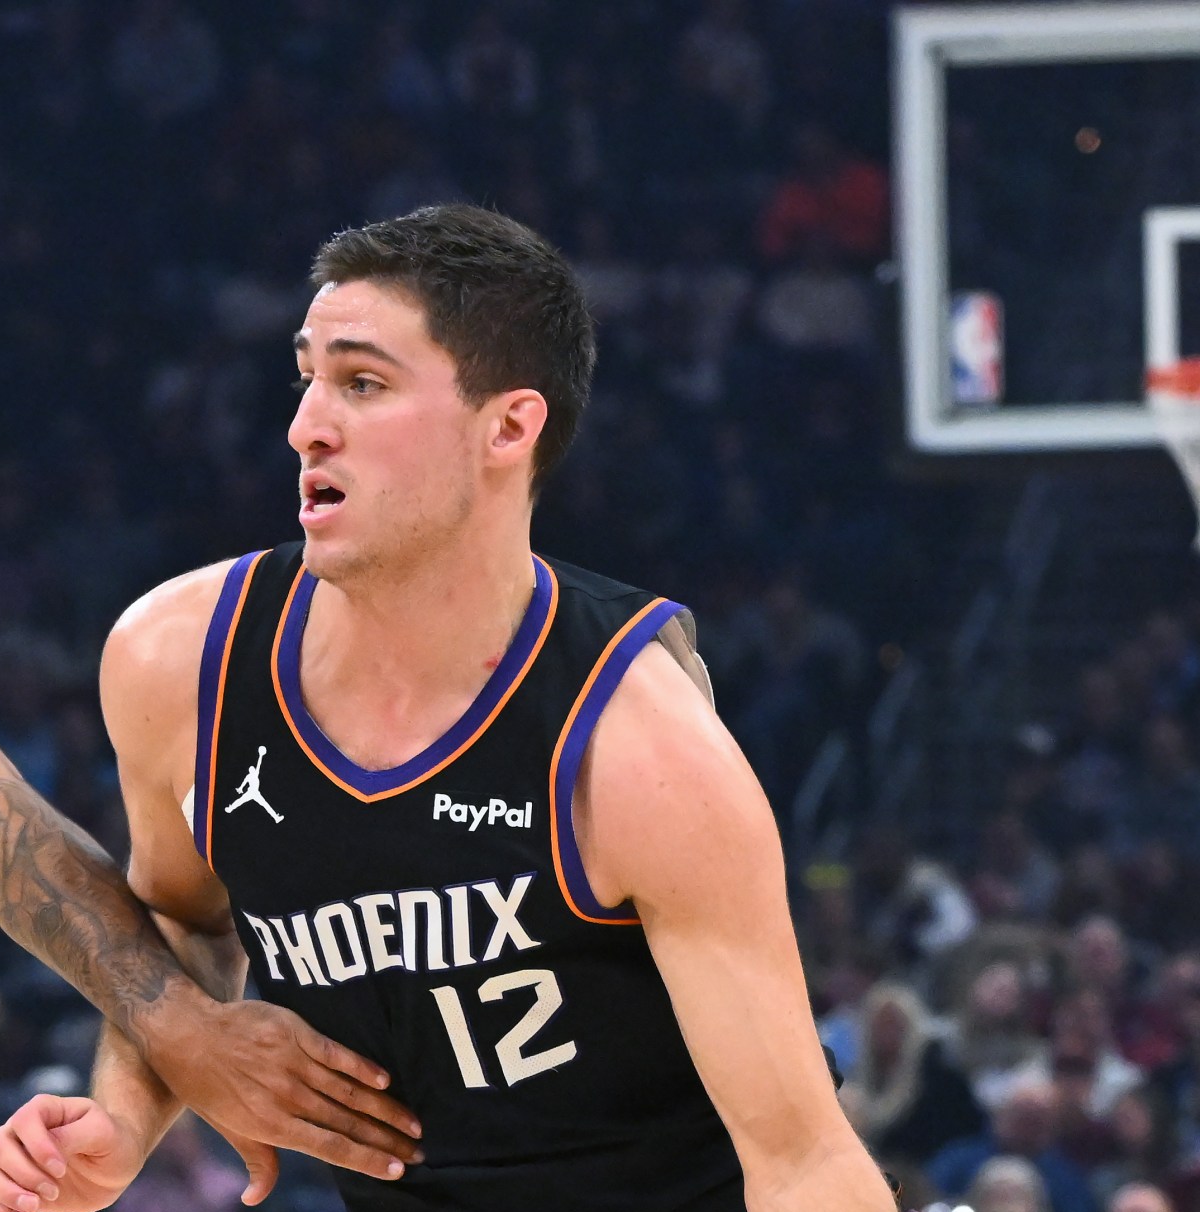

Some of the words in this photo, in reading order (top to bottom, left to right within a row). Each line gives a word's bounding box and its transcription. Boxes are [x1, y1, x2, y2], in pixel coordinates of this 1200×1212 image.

[433, 793, 533, 832] PayPal
[241, 872, 546, 987] PHOENIX
[428, 968, 578, 1089] 12
